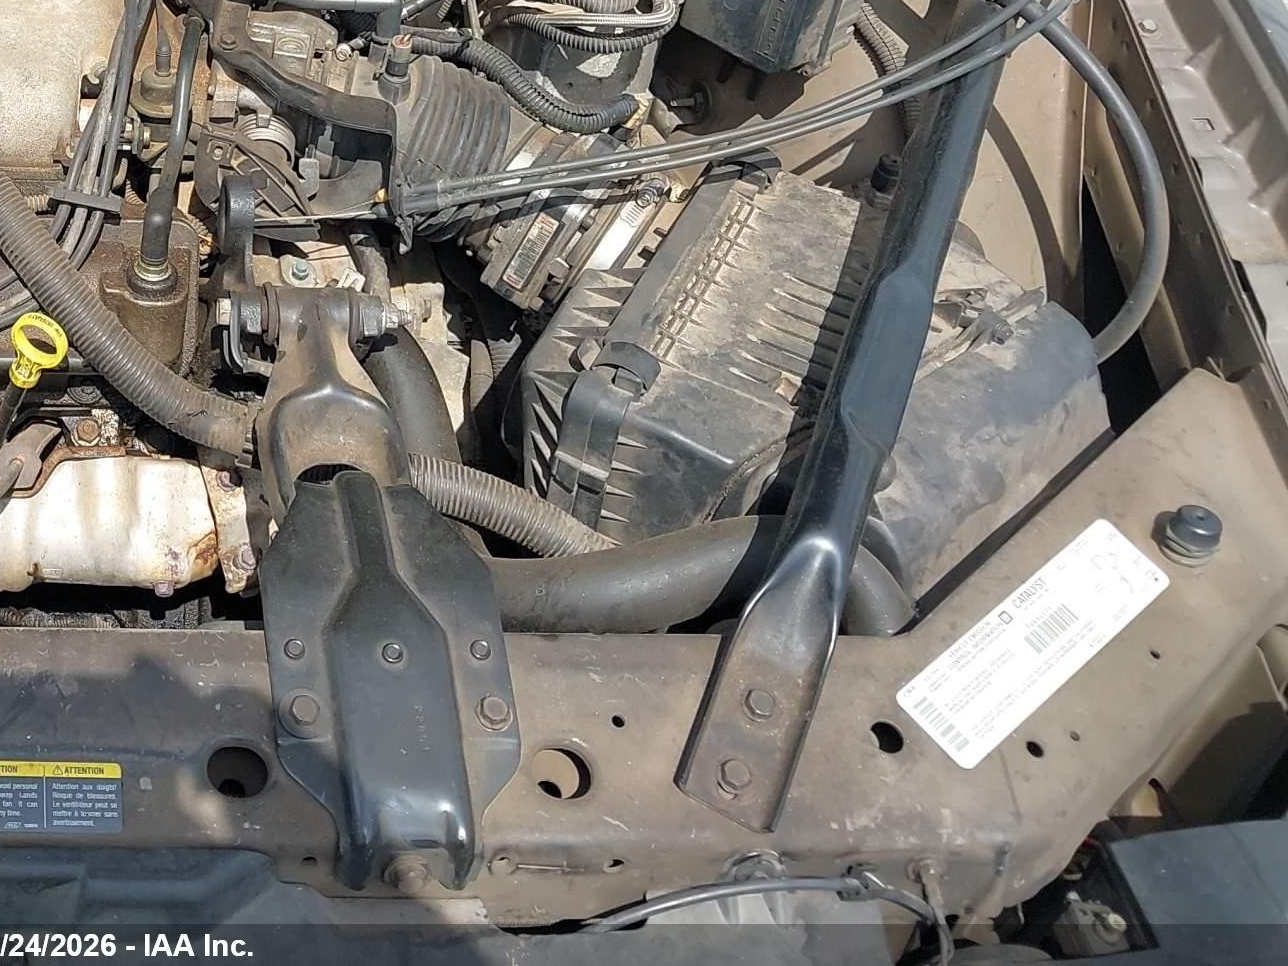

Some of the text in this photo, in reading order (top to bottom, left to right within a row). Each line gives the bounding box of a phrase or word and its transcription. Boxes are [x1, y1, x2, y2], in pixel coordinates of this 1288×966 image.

[1011, 575, 1047, 610] CATALYST
[64, 766, 104, 775] ATTENTION
[12, 783, 38, 791] personal
[52, 792, 72, 800] Risque
